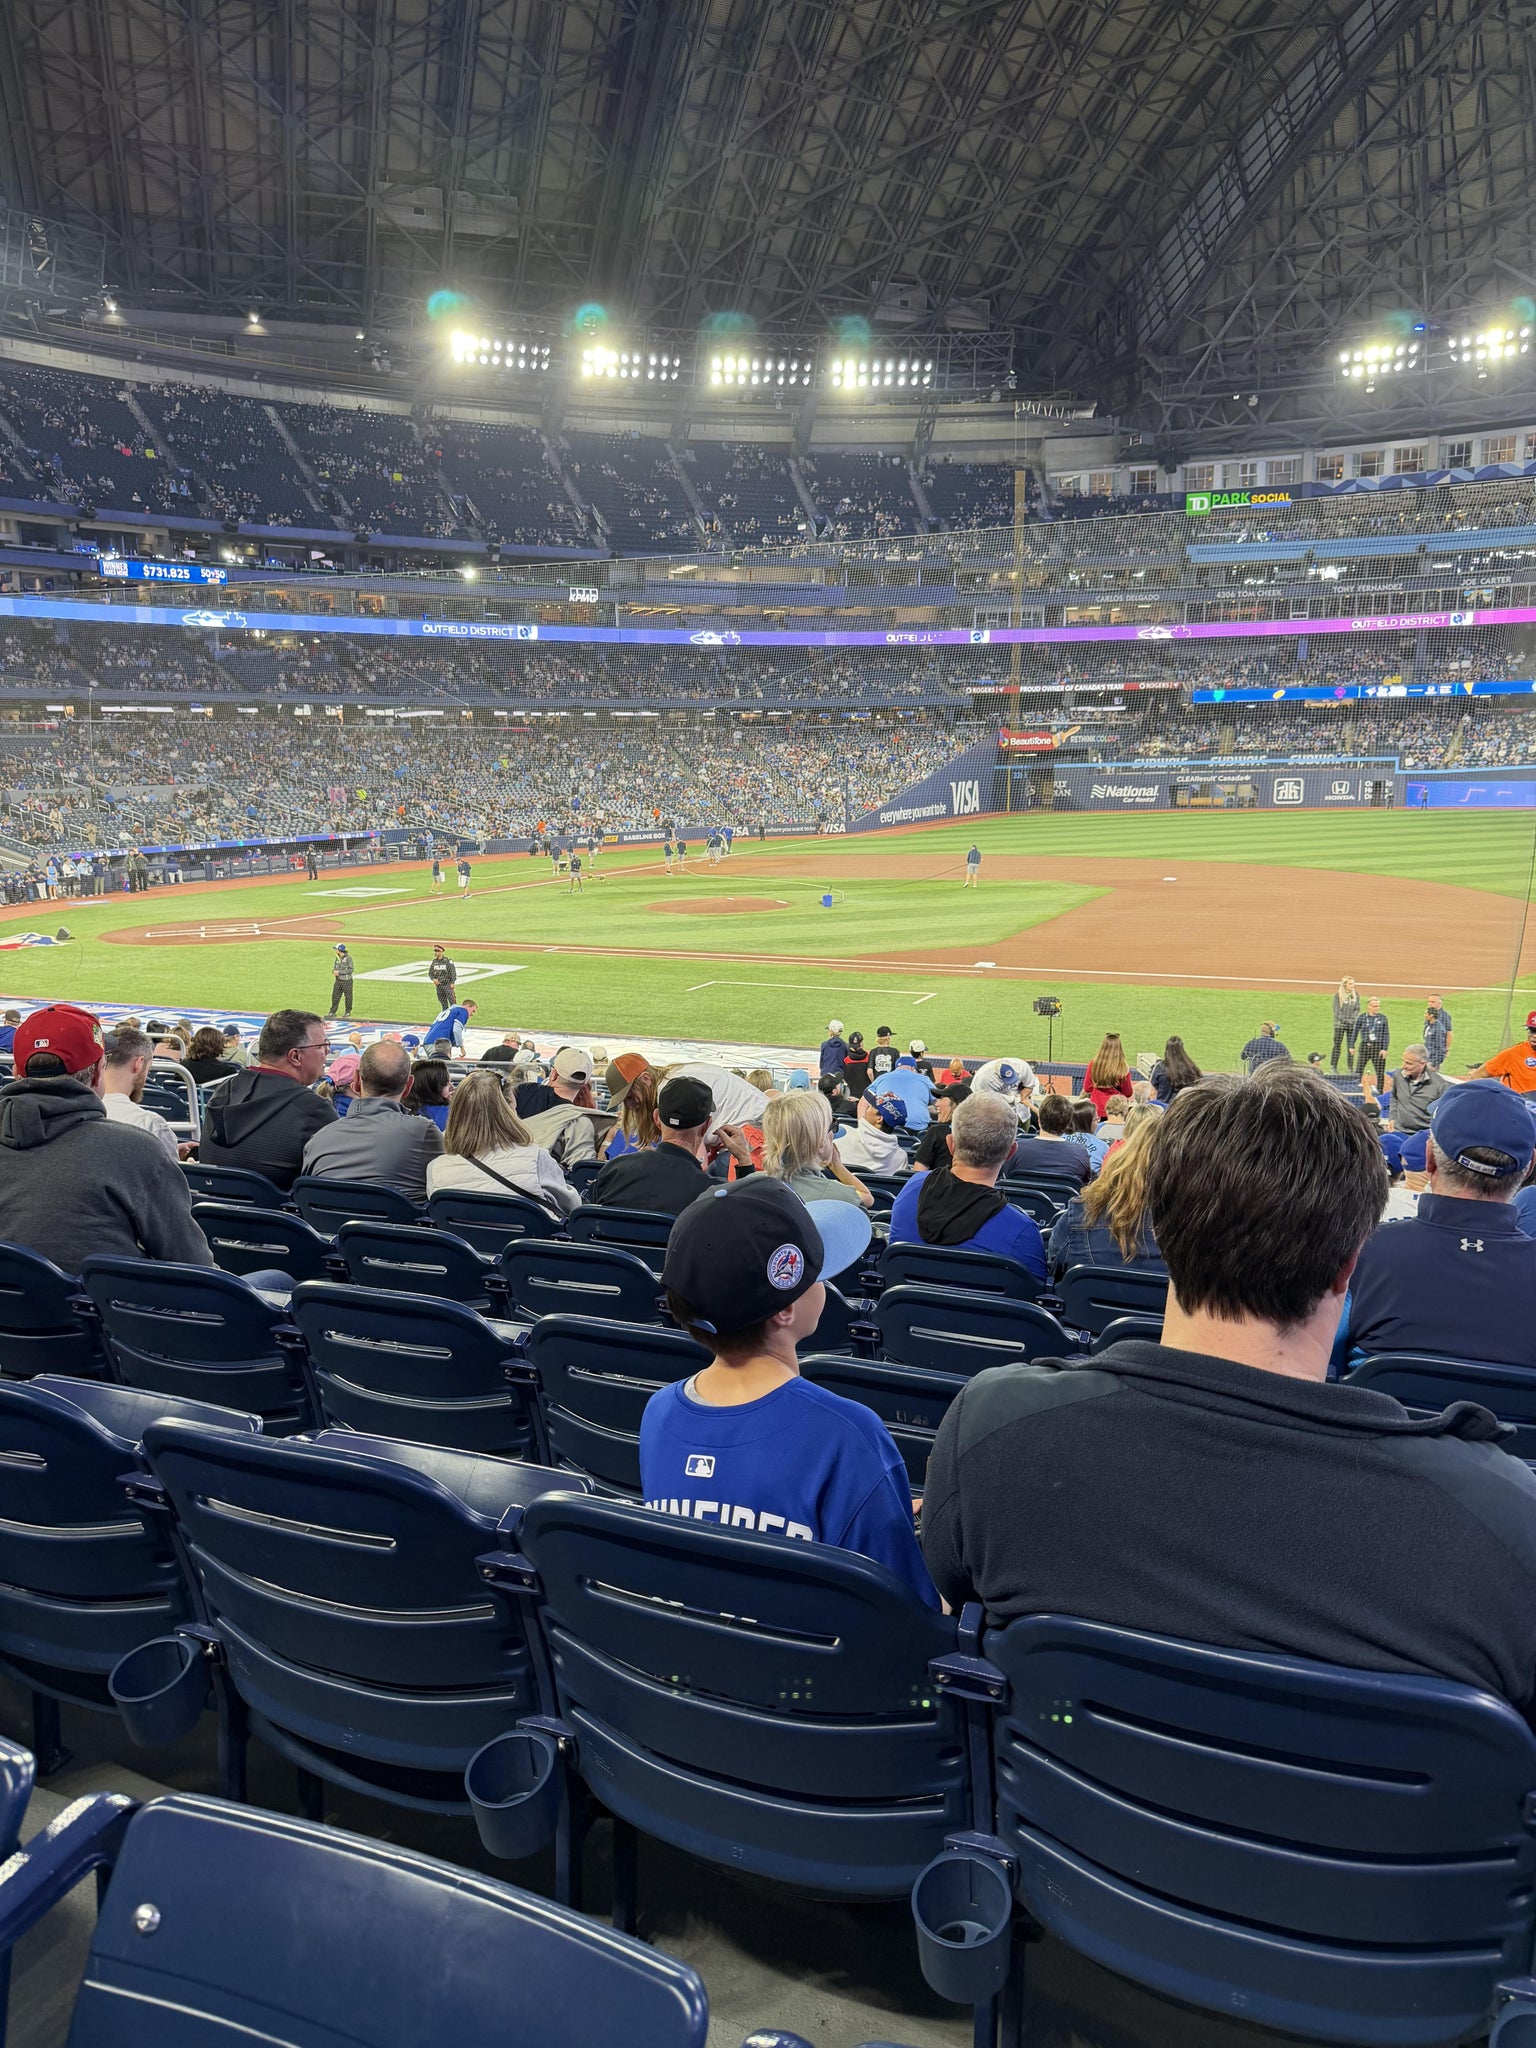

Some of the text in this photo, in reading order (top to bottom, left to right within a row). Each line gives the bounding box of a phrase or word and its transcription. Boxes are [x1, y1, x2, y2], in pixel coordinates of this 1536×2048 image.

[1188, 496, 1209, 511] TD
[1212, 491, 1292, 505] PARK SOCIAL
[143, 564, 190, 579] $731,825
[1461, 576, 1511, 586] JOE CARTER
[1237, 590, 1255, 598] TOM
[1257, 589, 1282, 597] CHEEK
[1333, 583, 1403, 593] TONY FERNANDEZ
[569, 592, 598, 603] KPMG
[1126, 593, 1160, 601] DELGADO
[1351, 615, 1448, 629] OUTFIELD DISTRICT
[422, 624, 514, 637] OUTFIELD DISTRICT
[972, 686, 995, 694] ROGERS
[950, 781, 980, 815] VISA
[624, 833, 653, 841] BASELINE
